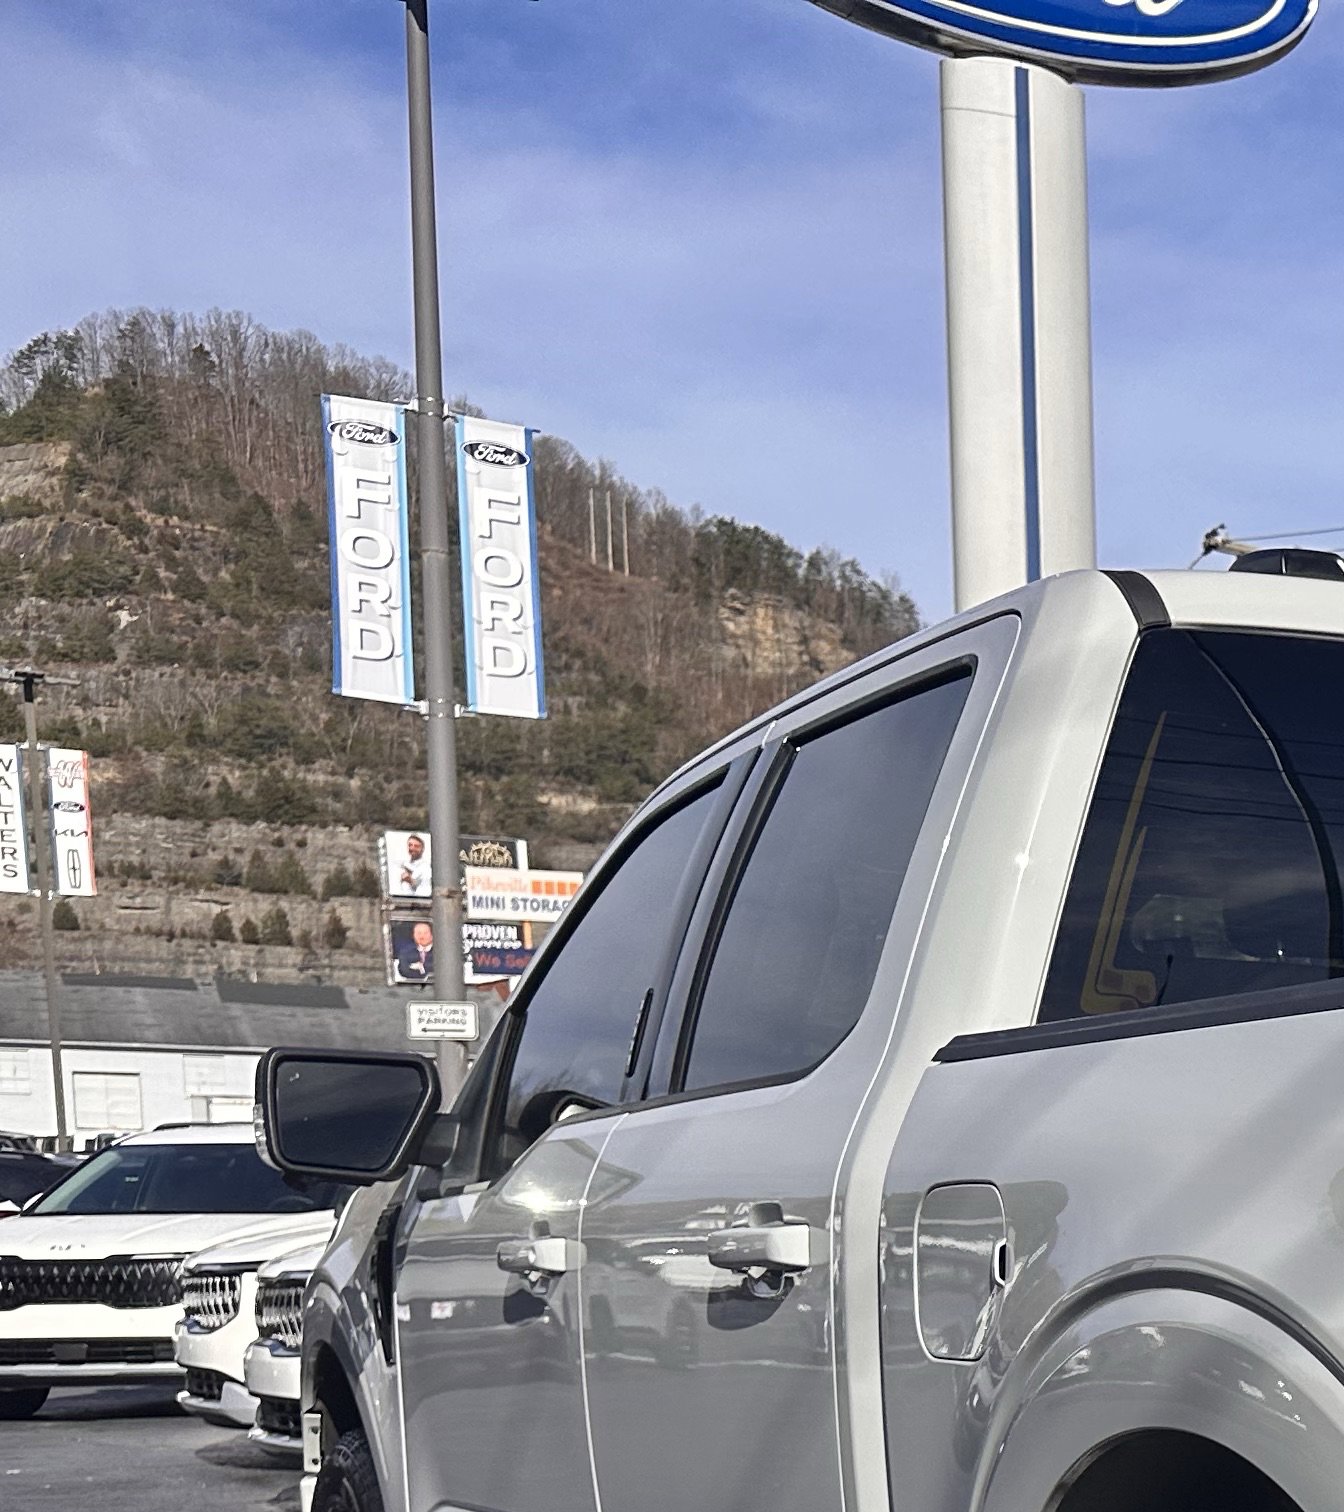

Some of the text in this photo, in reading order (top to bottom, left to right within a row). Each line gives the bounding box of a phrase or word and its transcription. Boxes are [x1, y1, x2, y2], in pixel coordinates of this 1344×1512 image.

[340, 421, 388, 444] Ford
[473, 444, 519, 466] Ford
[340, 467, 396, 662] FORD
[473, 488, 528, 678] FORD
[472, 895, 505, 911] MINI
